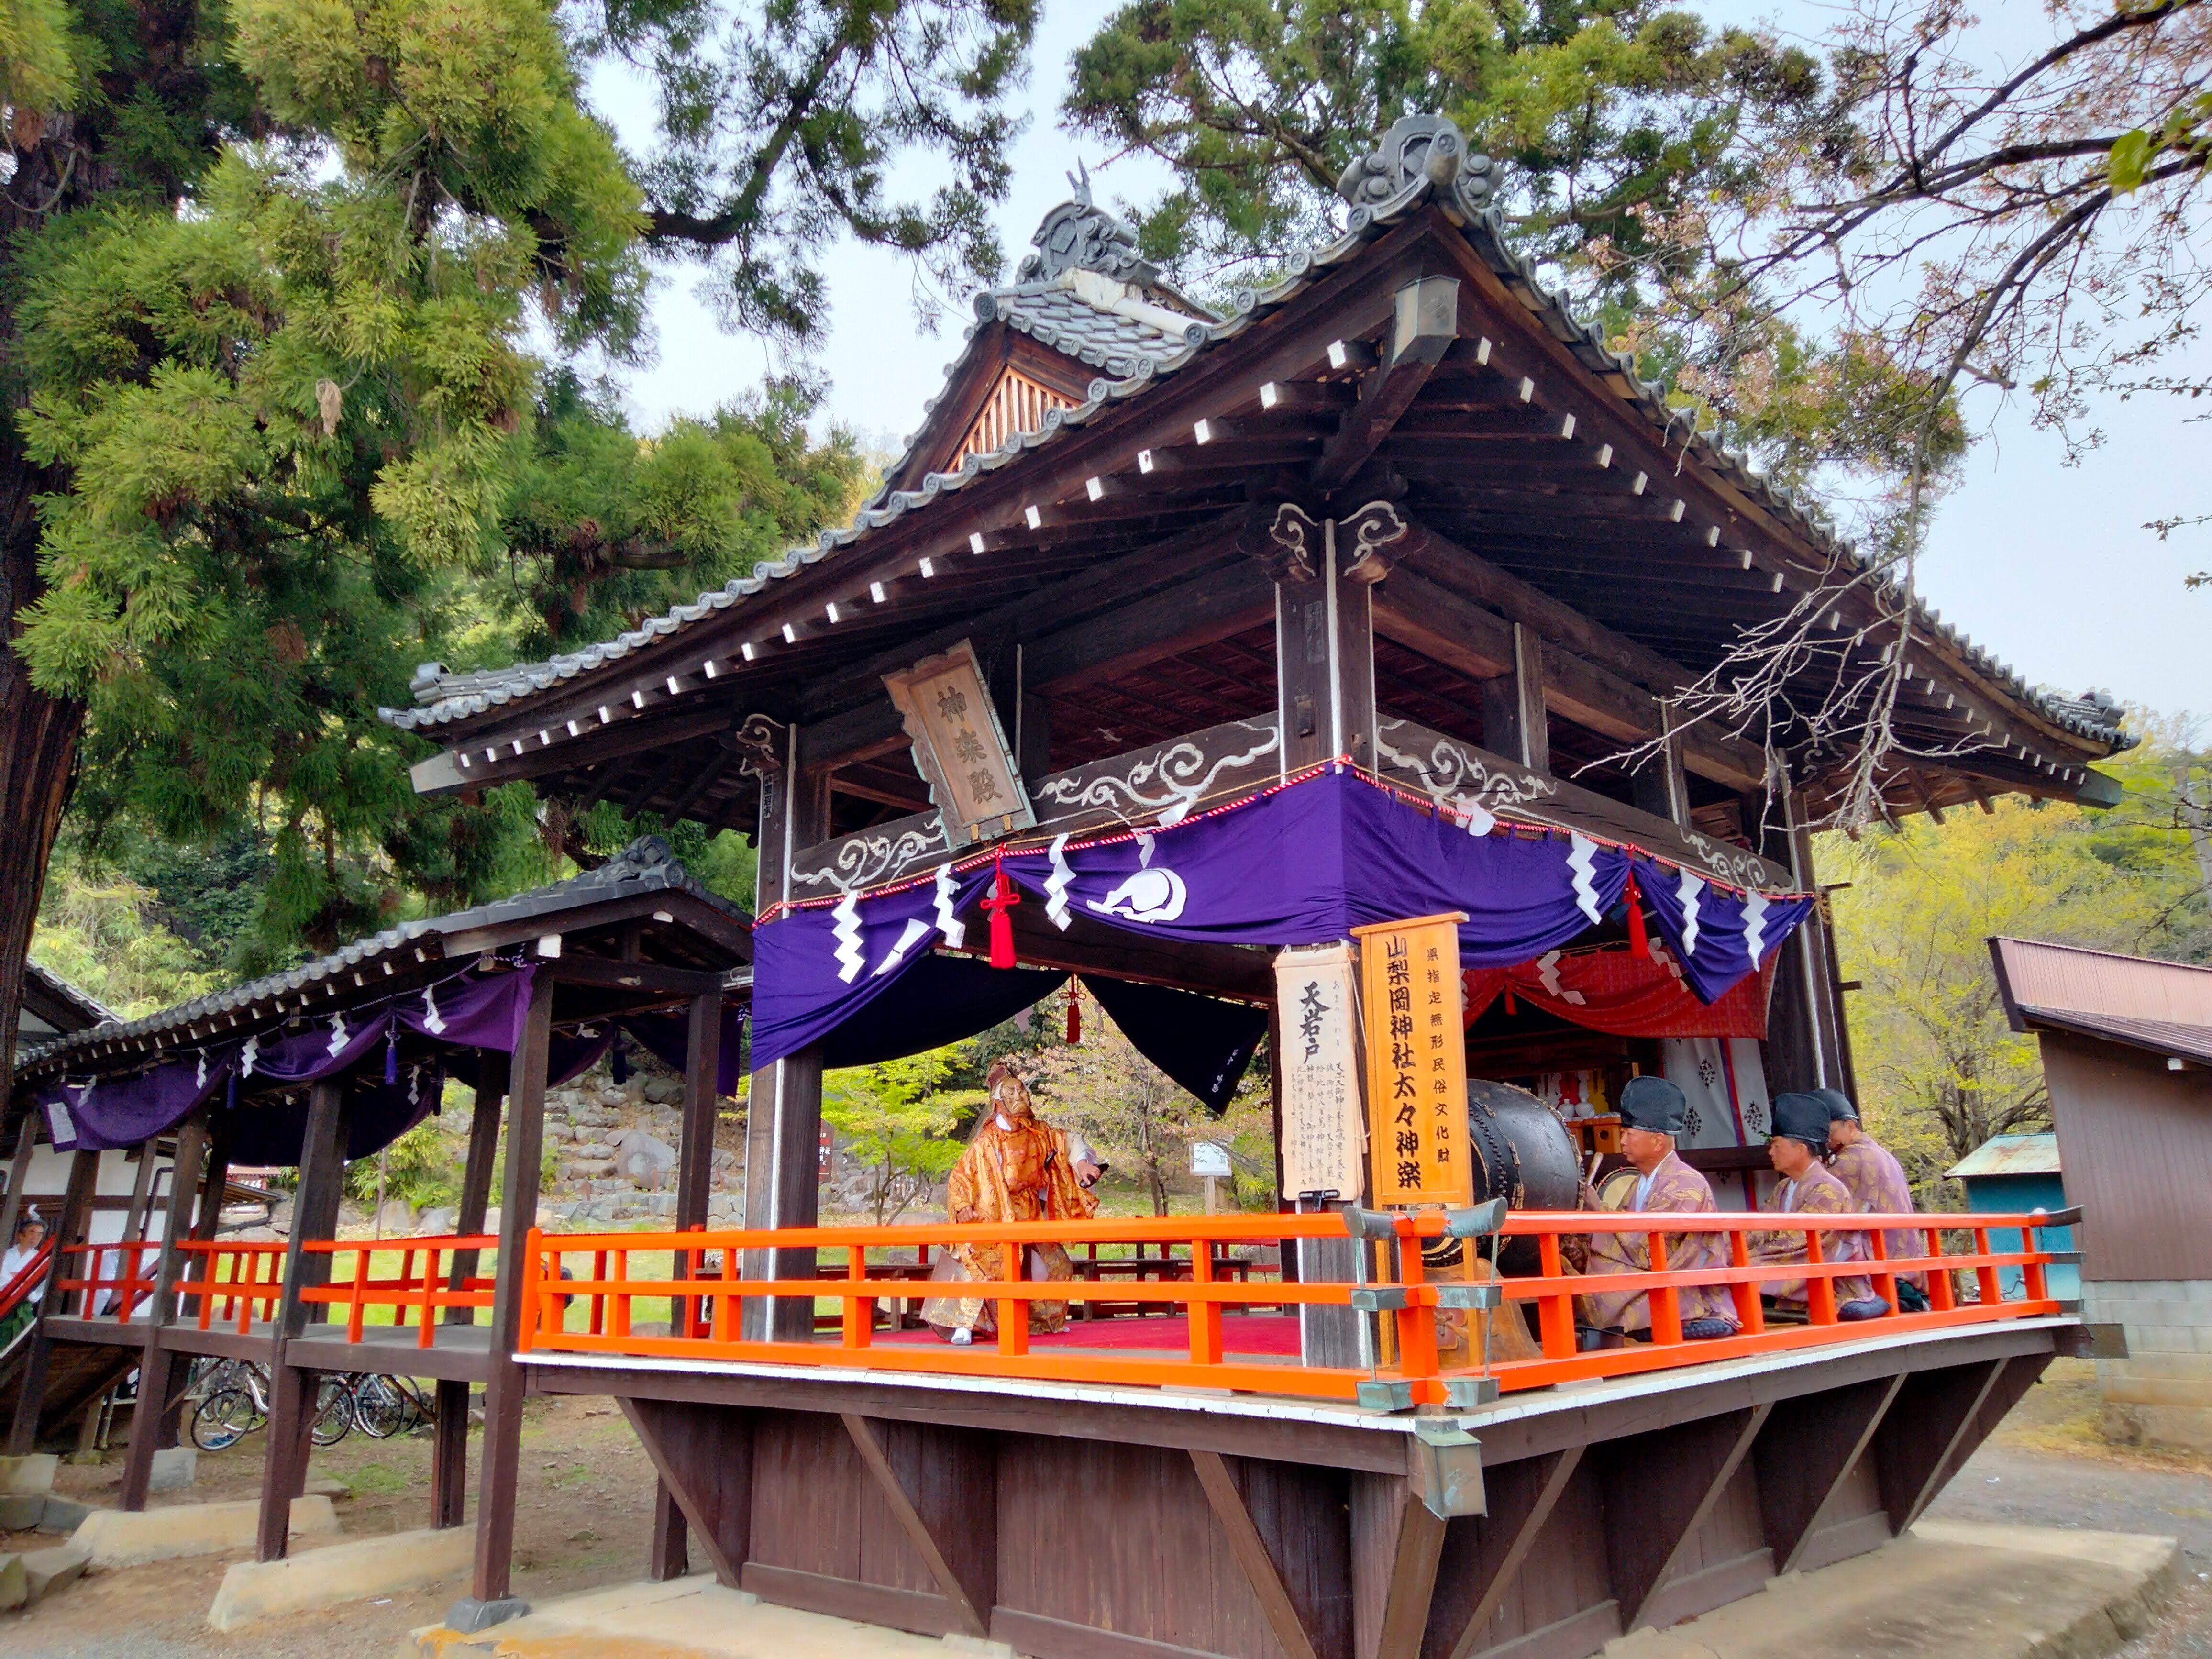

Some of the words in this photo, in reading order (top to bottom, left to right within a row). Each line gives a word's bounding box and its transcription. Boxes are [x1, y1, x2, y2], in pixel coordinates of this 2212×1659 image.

[937, 686, 1003, 805] 神楽殿
[1299, 981, 1331, 1063] 天岩戸
[1385, 935, 1421, 1189] 山梨岡神社太々神楽
[1426, 947, 1450, 1163] 県指定無形民俗文化財
